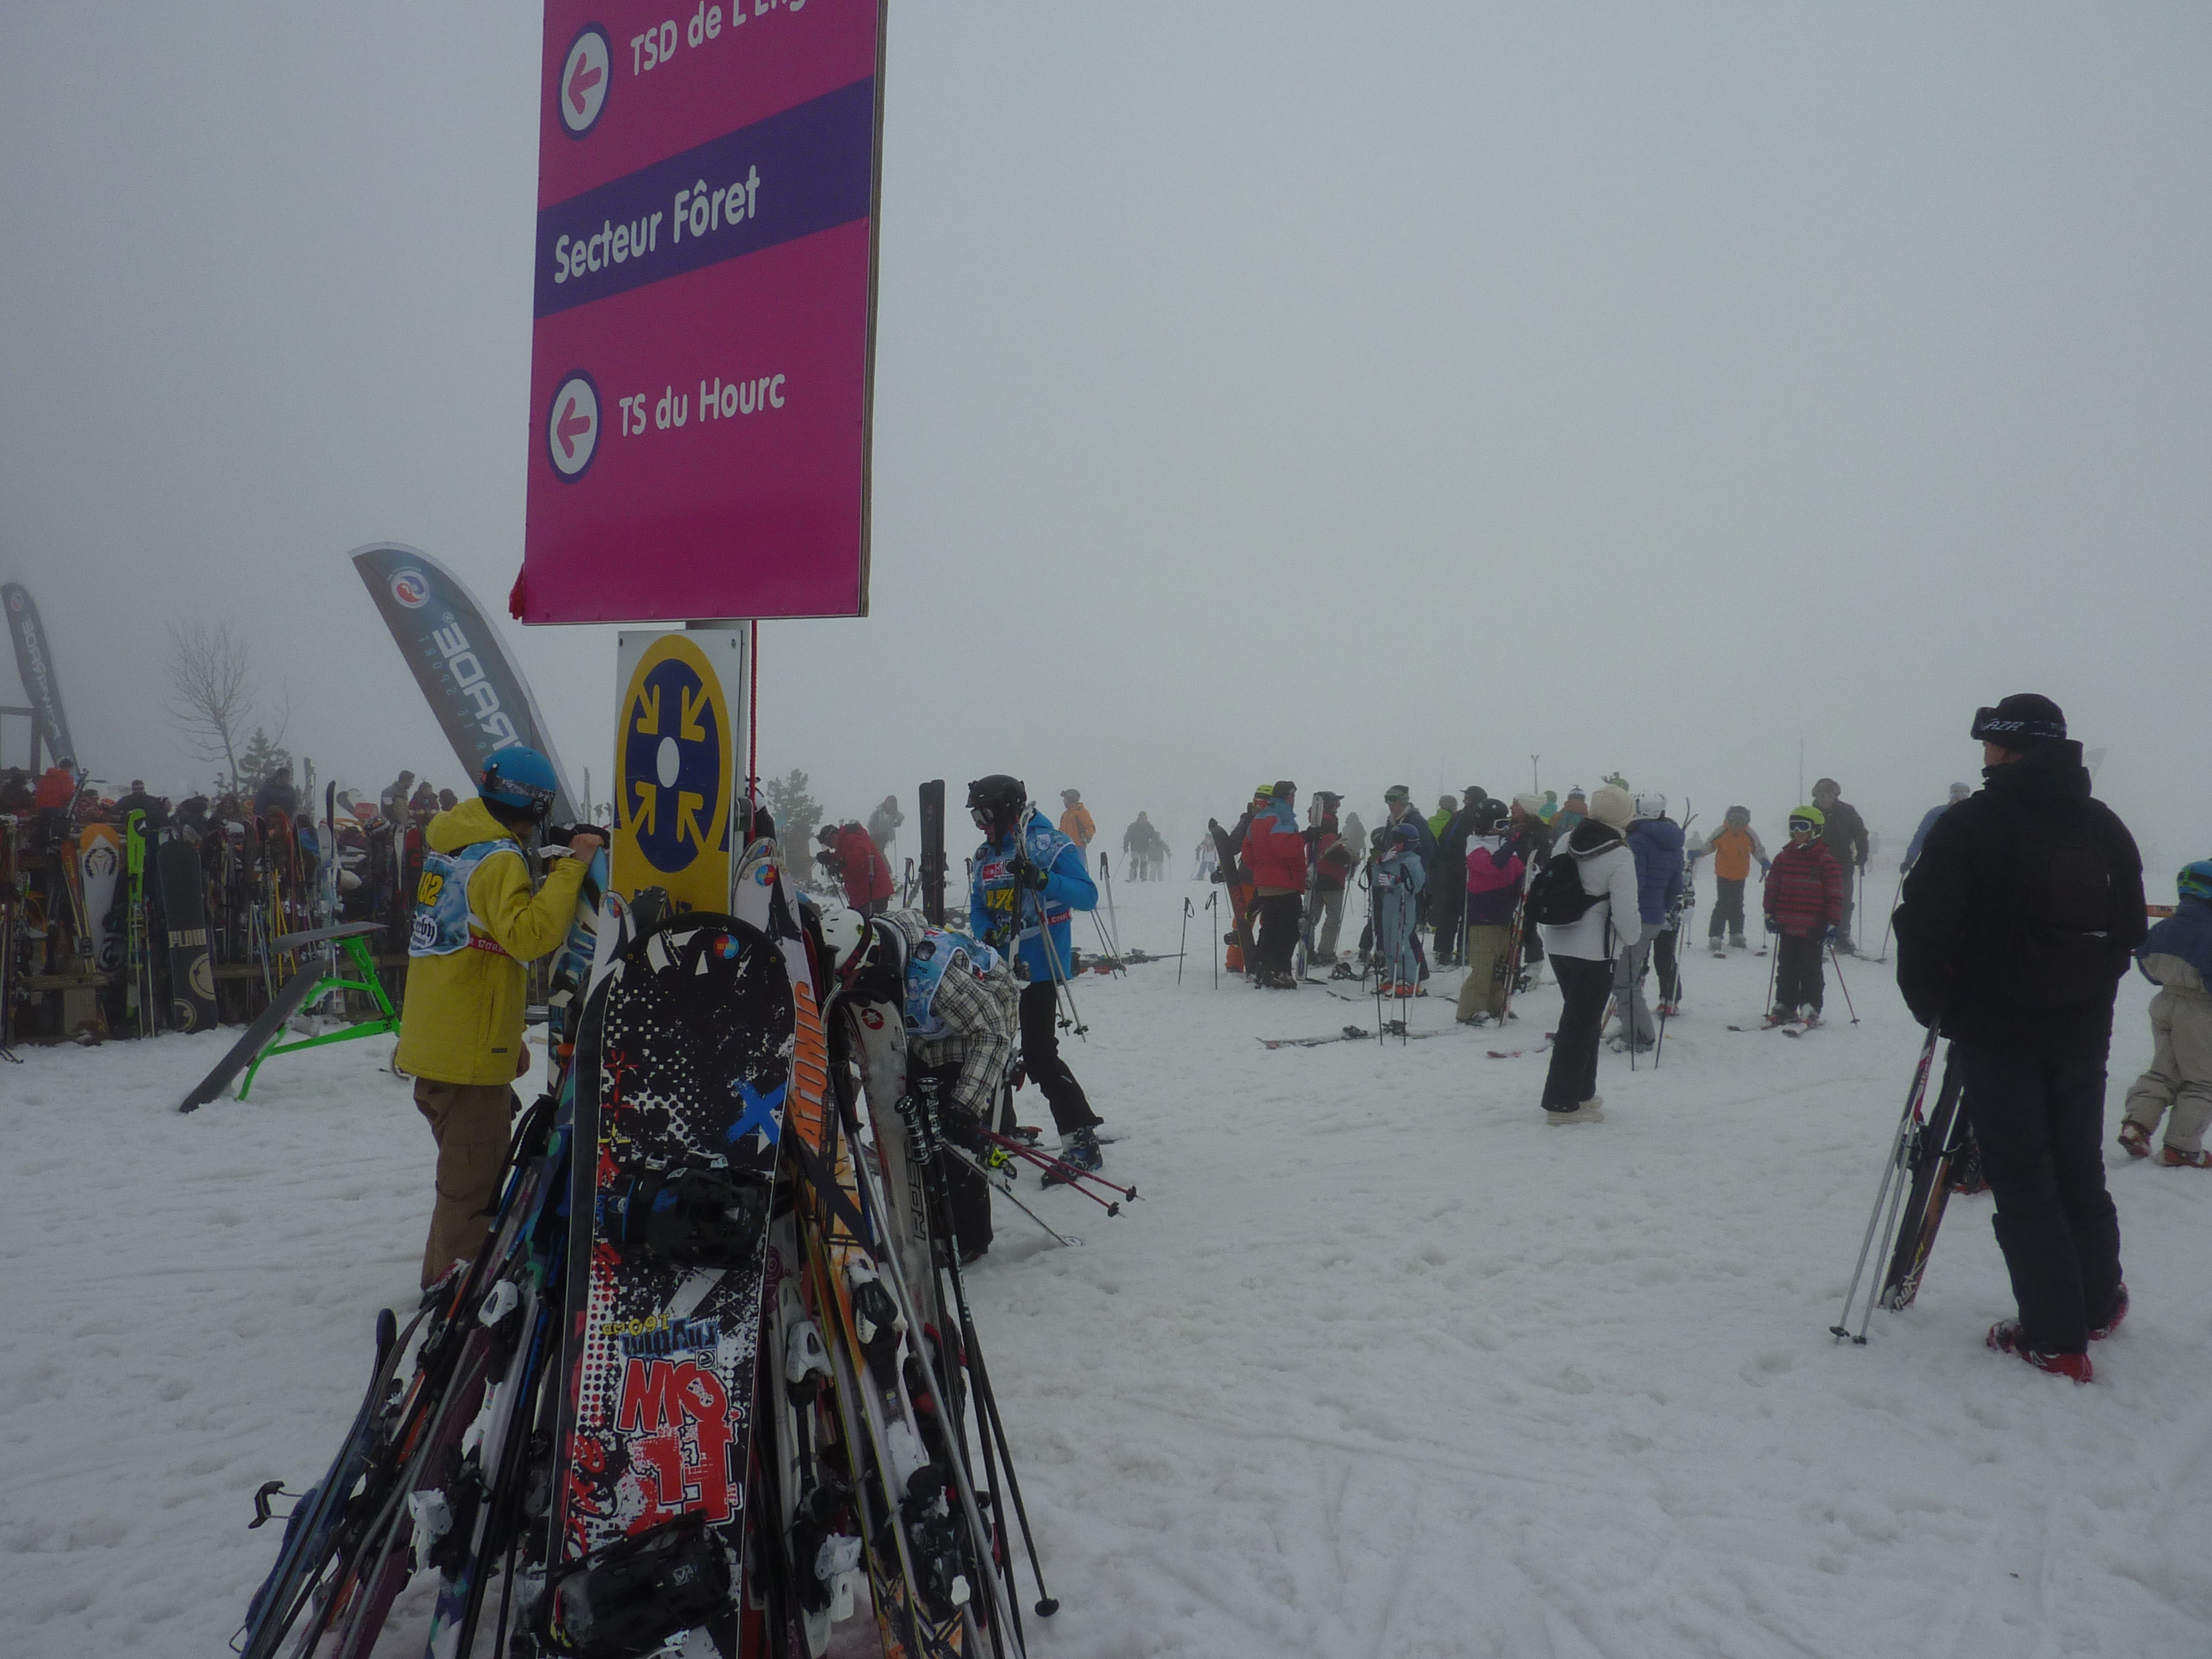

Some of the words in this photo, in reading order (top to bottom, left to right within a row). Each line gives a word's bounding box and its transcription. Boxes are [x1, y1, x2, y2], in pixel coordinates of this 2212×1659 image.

[630, 19, 678, 76] TSD
[688, 1, 722, 48] de
[554, 210, 663, 284] Secteur
[673, 164, 760, 244] Fôret
[618, 393, 647, 437] TS
[655, 386, 688, 430] du
[699, 374, 786, 423] Hourc
[795, 981, 827, 1150] ATOMIC
